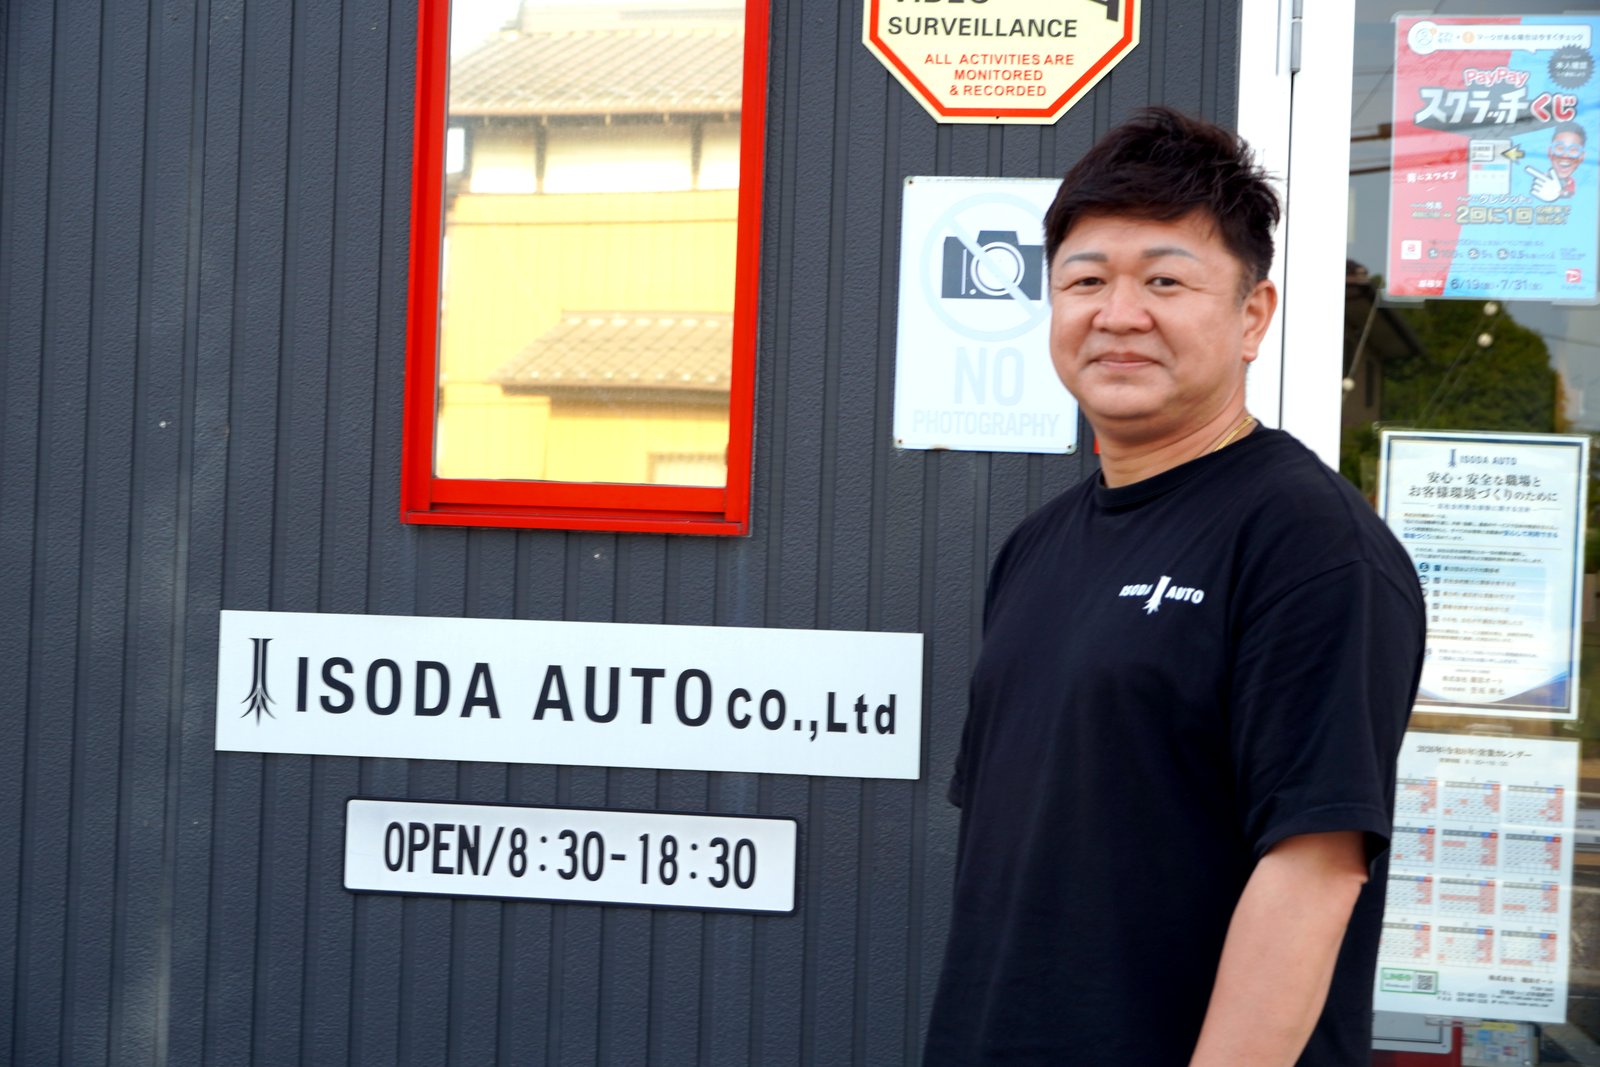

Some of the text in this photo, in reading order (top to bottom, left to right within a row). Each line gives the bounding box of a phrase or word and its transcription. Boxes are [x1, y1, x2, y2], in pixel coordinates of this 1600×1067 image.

[888, 16, 1077, 38] SURVEILLANCE
[925, 54, 1074, 66] ALL ACTIVITIES ARE
[954, 69, 1043, 81] MONITORED
[1464, 67, 1529, 87] PayPay
[949, 85, 1047, 97] & RECORDED
[1414, 87, 1577, 124] スクラッチくじ
[954, 346, 1025, 406] NO
[912, 410, 1061, 438] PHOTOGRAPHY
[1427, 471, 1542, 488] 安心・安全な職場と
[1408, 485, 1558, 502] お客様環境づくりのために
[1165, 586, 1205, 604] AUTO
[296, 656, 501, 719] ISODA
[532, 664, 713, 727] AUTO
[384, 821, 757, 890] OPEN/8:30-18:30
